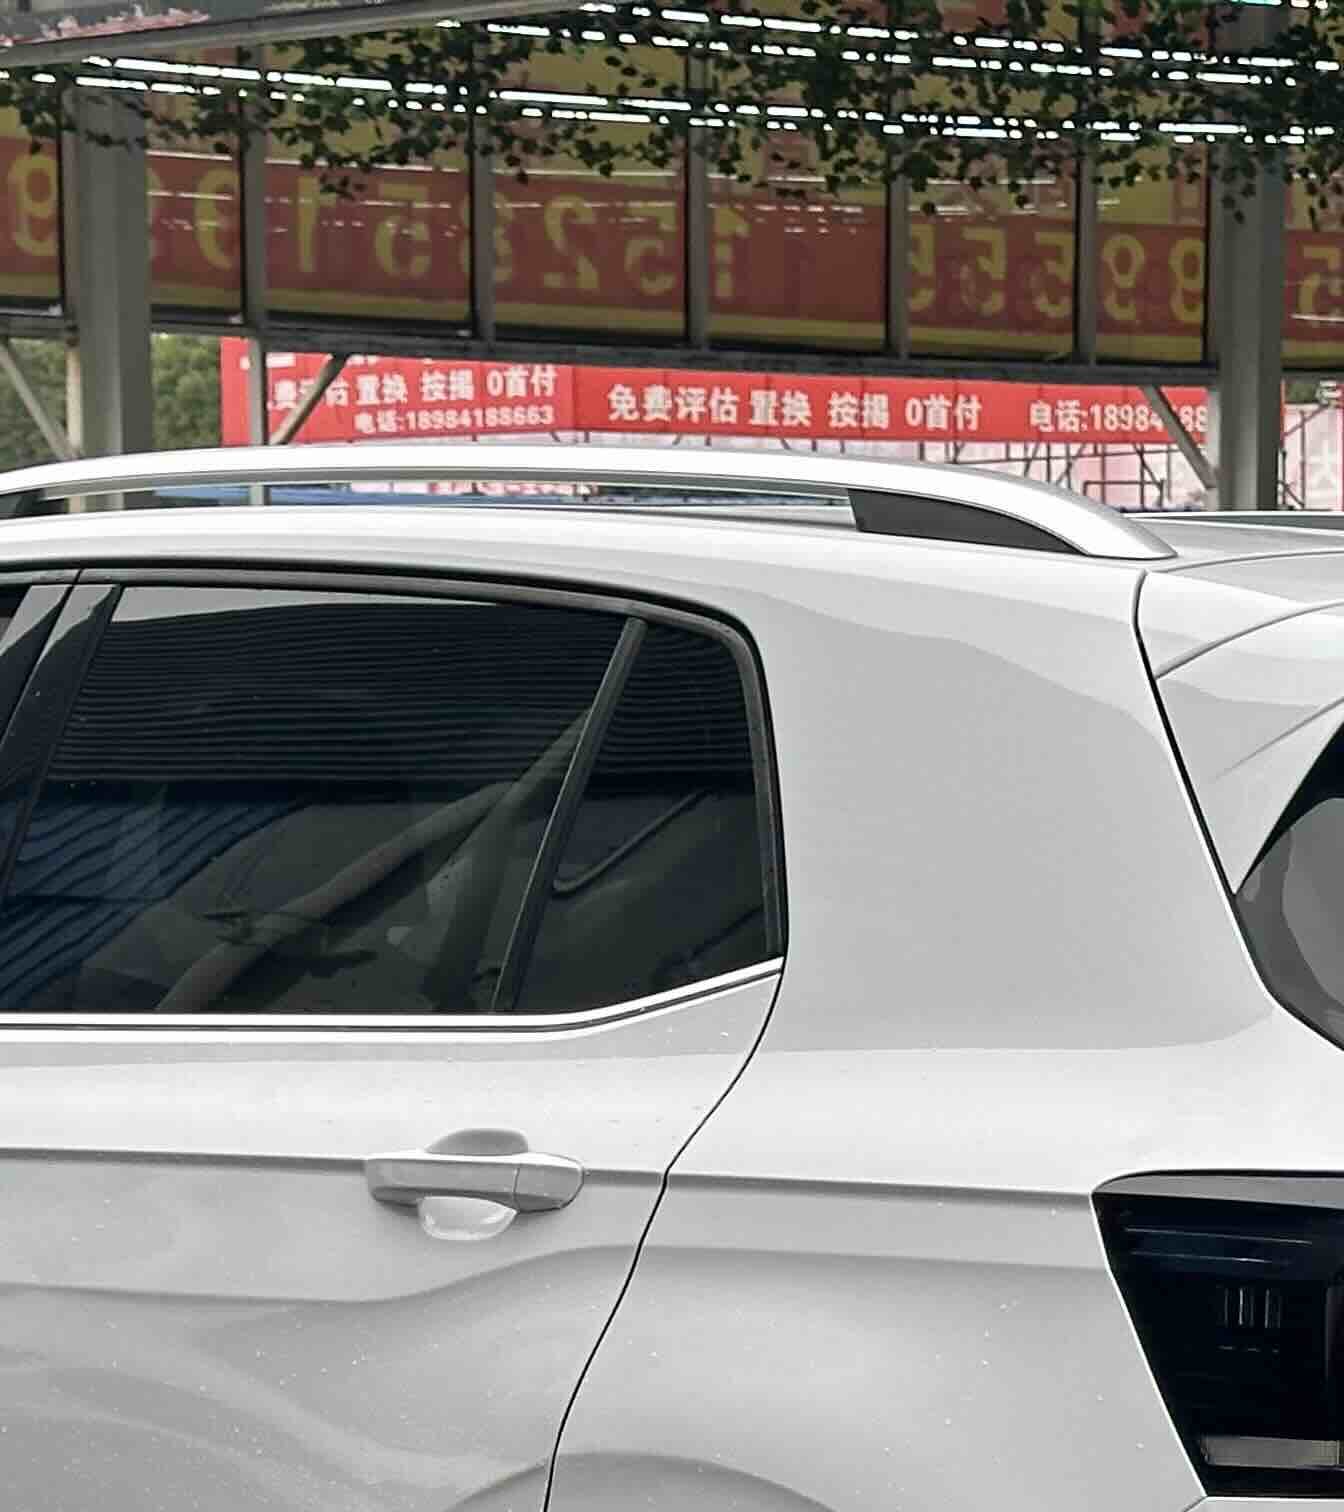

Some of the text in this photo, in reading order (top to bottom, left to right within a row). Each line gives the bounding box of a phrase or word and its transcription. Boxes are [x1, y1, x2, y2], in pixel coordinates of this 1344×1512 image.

[607, 383, 740, 425] 免费评估
[747, 389, 812, 427] 置换
[827, 390, 889, 429] 按揭
[905, 393, 982, 432] 0首付
